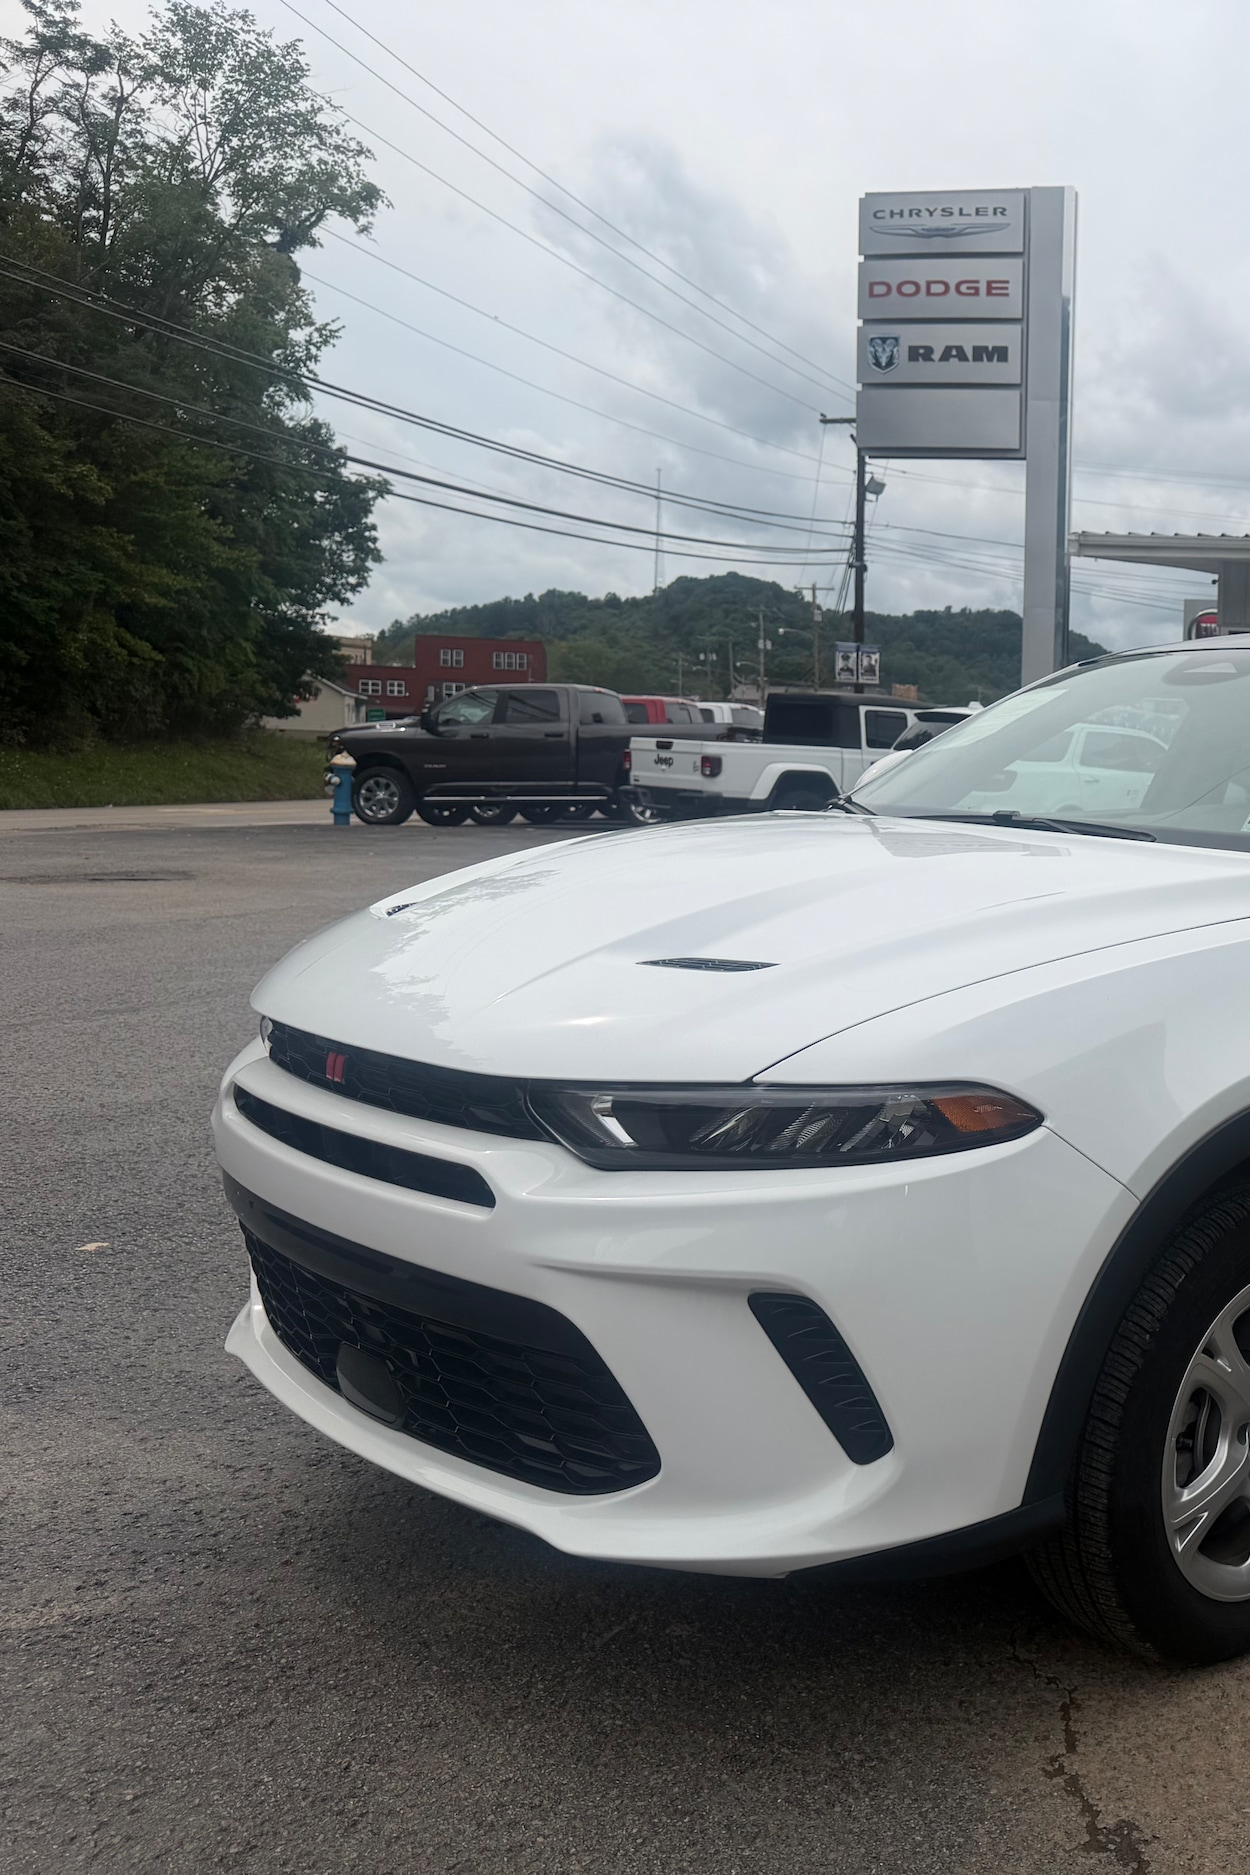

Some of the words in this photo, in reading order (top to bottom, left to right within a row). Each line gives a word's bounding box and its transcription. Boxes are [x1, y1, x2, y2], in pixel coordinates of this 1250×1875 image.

[872, 206, 1008, 220] CHRYSLER
[868, 279, 1010, 299] DODGE
[907, 345, 1009, 363] RAM
[654, 753, 674, 767] Jeep
